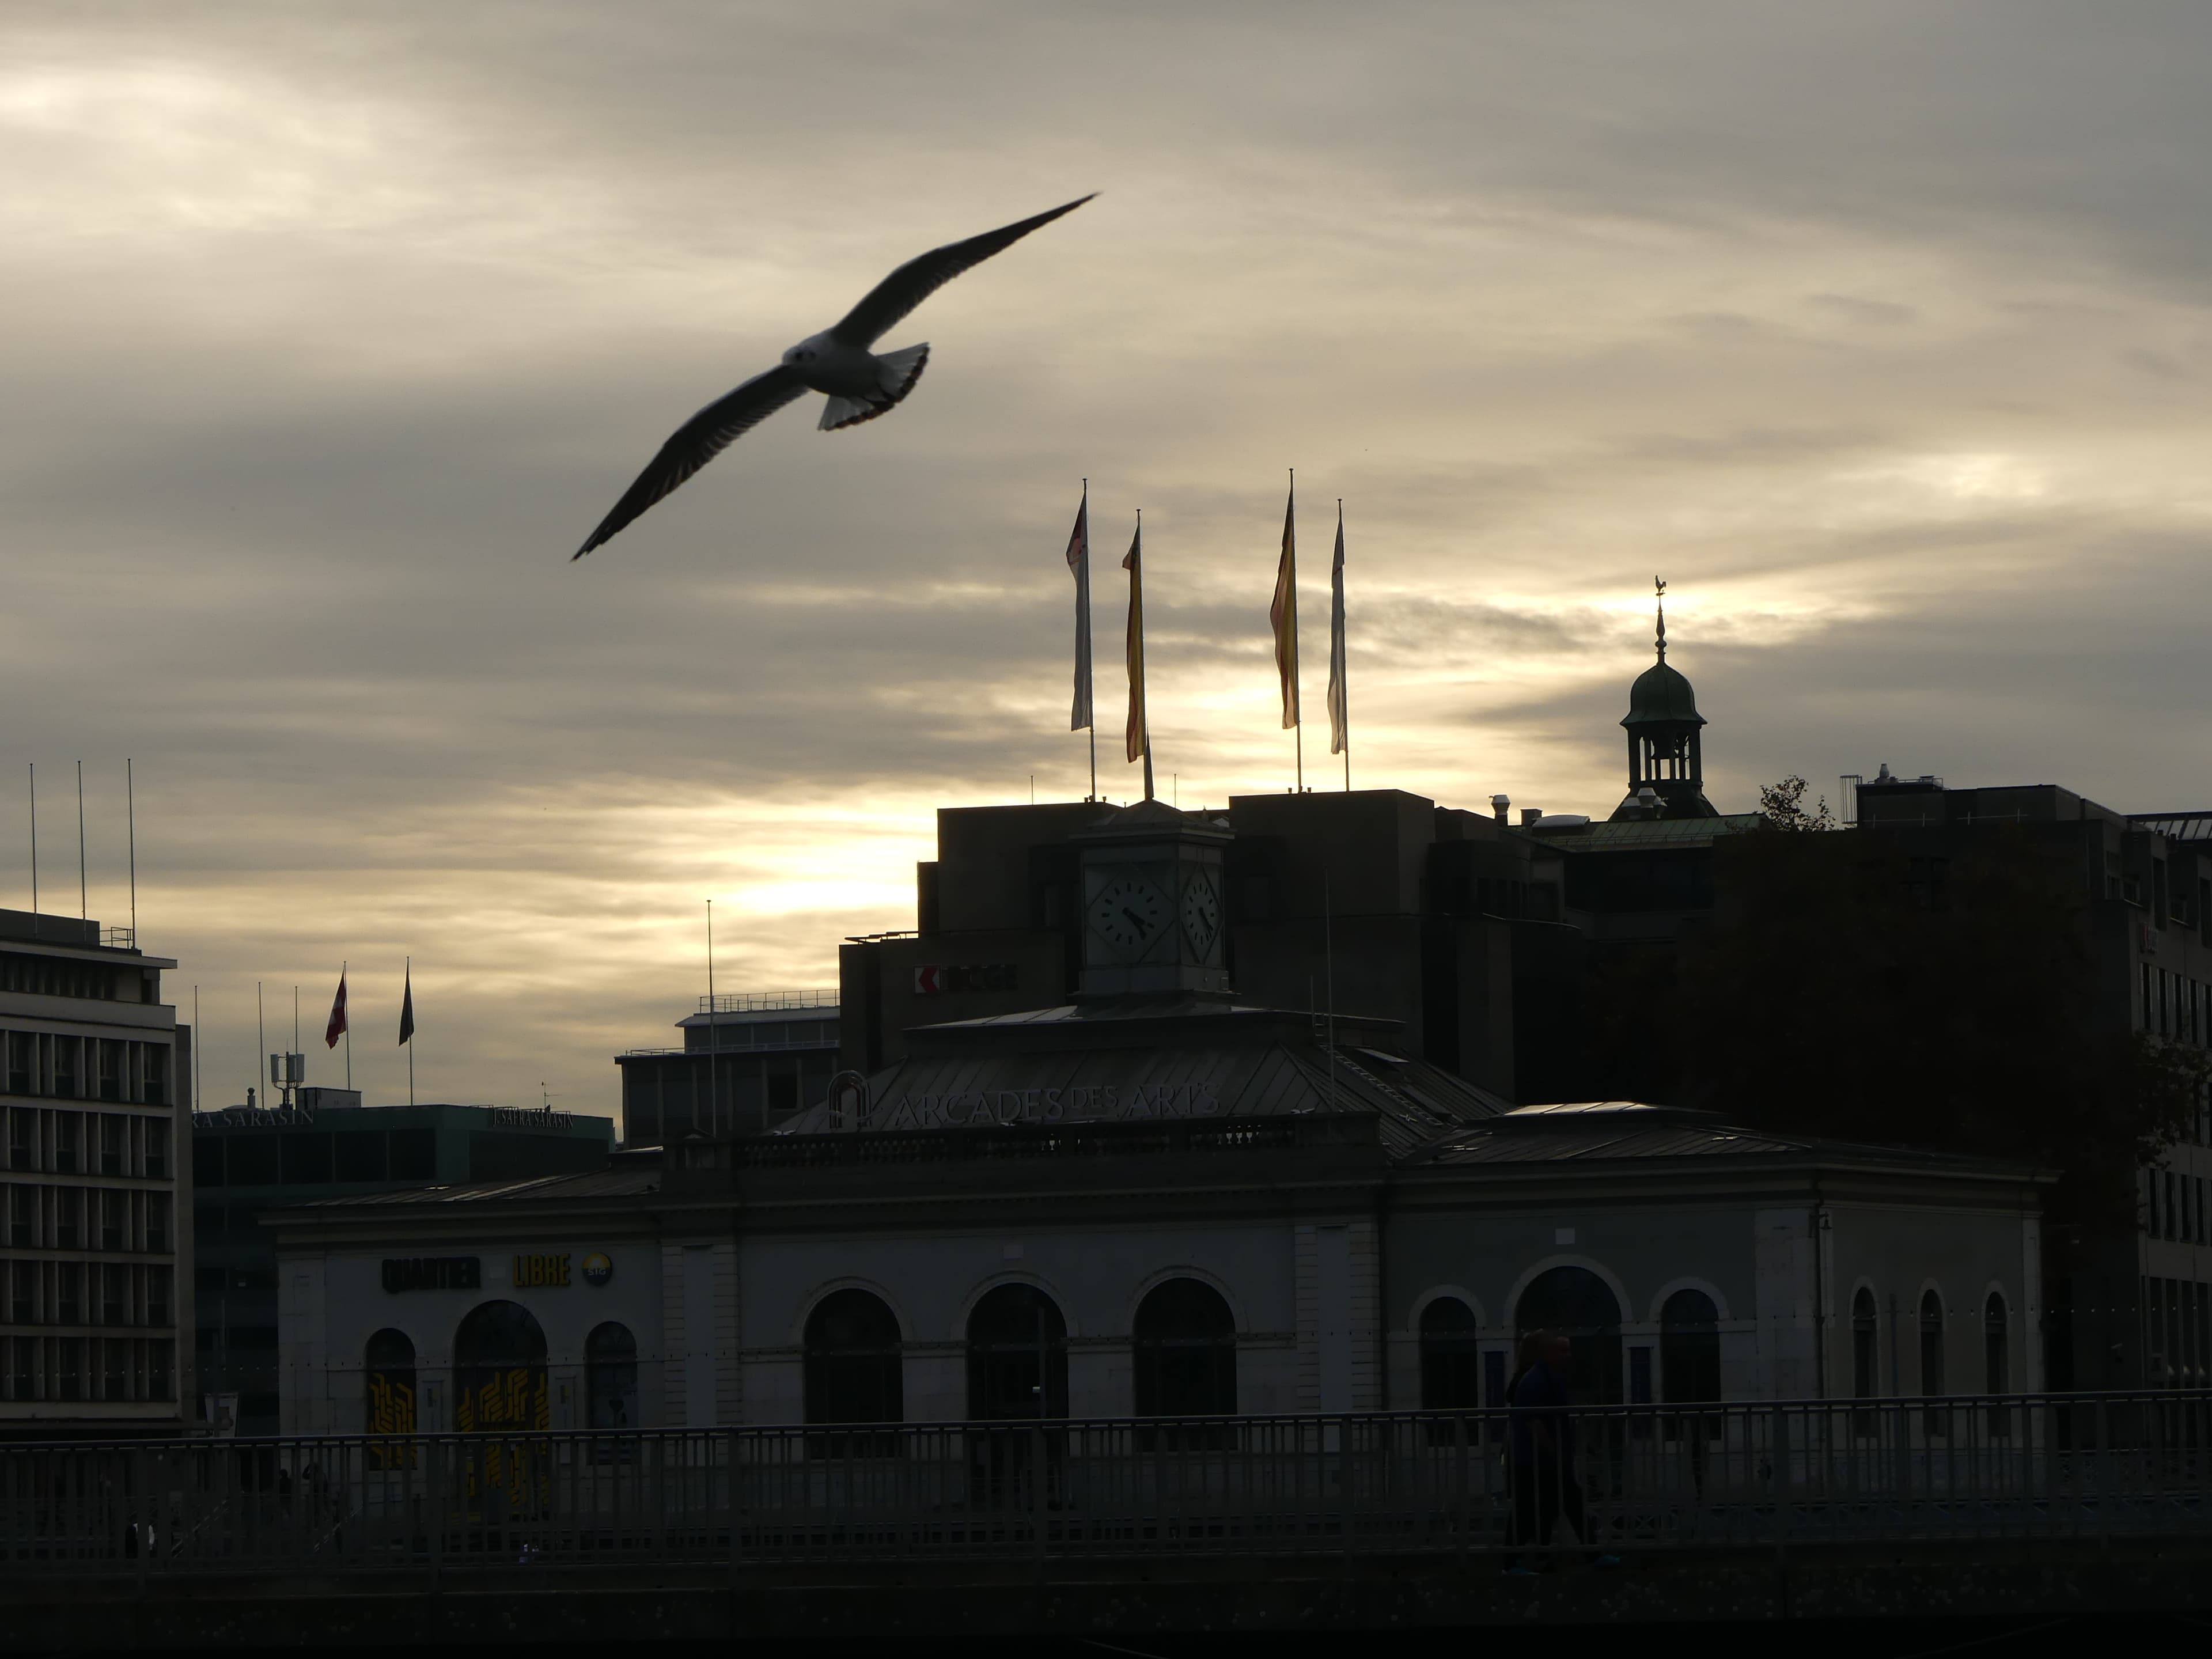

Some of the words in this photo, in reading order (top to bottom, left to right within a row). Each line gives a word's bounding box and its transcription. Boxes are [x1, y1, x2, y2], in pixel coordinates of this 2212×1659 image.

[895, 1088, 1065, 1126] ARCADES
[1070, 1085, 1119, 1107] DES
[1128, 1083, 1220, 1116] ARTS
[223, 1109, 314, 1128] SARASIN
[502, 1109, 531, 1126] SAFRA
[535, 1112, 574, 1129] SARASIN
[513, 1253, 571, 1287] LIBRE
[586, 1268, 607, 1277] SIG
